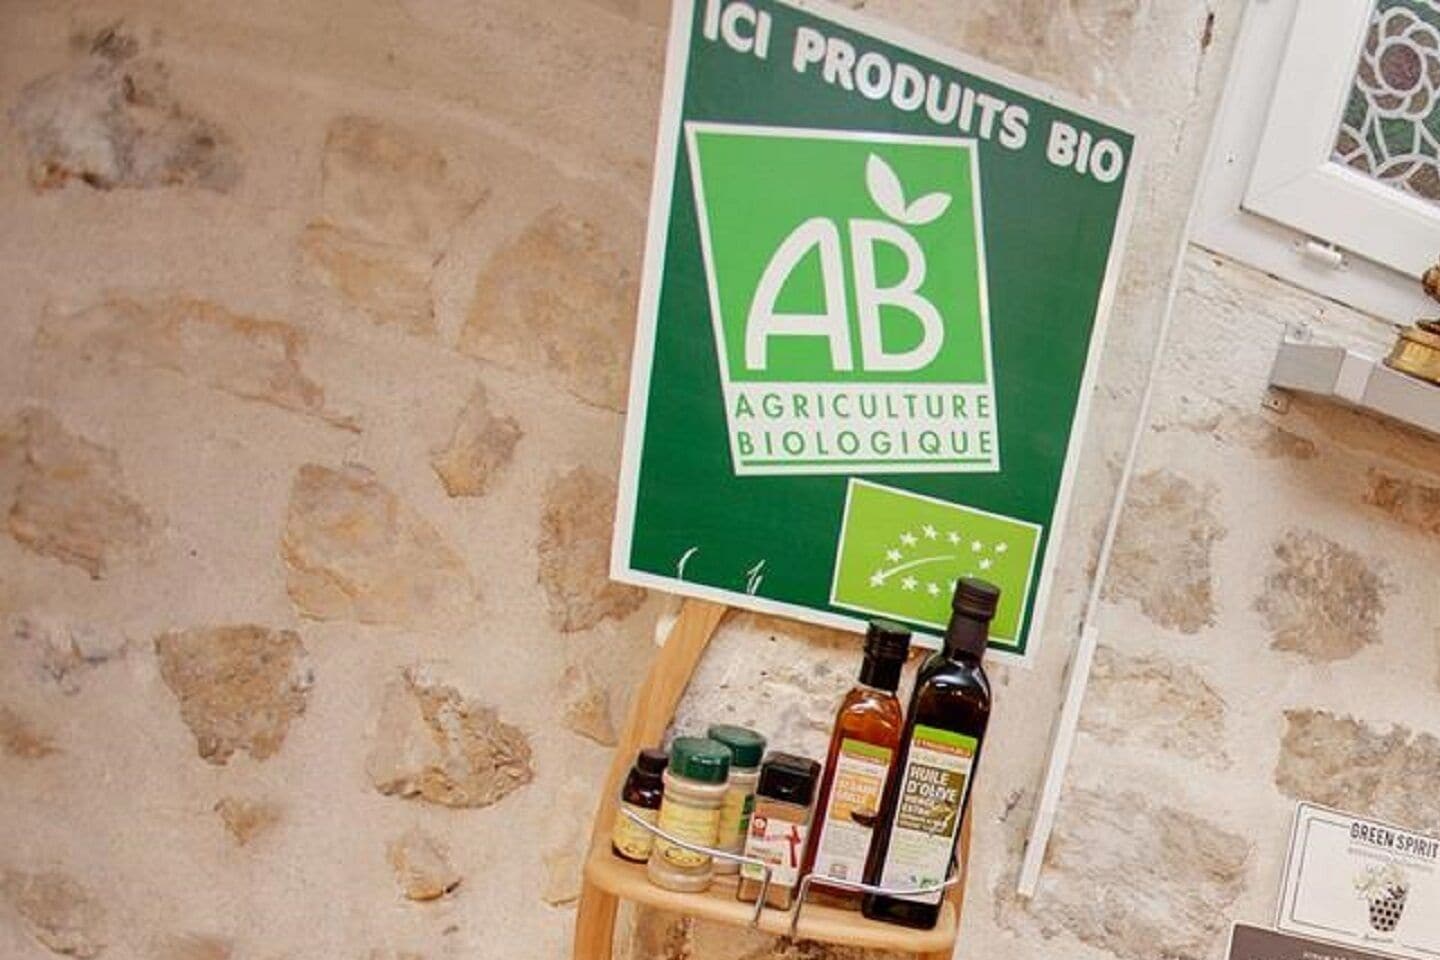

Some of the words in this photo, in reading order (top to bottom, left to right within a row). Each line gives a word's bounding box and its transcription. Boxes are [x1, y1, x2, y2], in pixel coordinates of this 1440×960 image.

[703, 0, 772, 58] ICI
[793, 27, 1030, 150] PRODUITS
[1047, 119, 1124, 183] BIO
[745, 217, 945, 372] AB
[735, 393, 990, 419] AGRICULTURE
[737, 430, 992, 455] BIOLOGIQUE
[910, 764, 950, 786] HUILE
[1349, 822, 1394, 847] GREEN
[1395, 833, 1440, 859] SPIRIT
